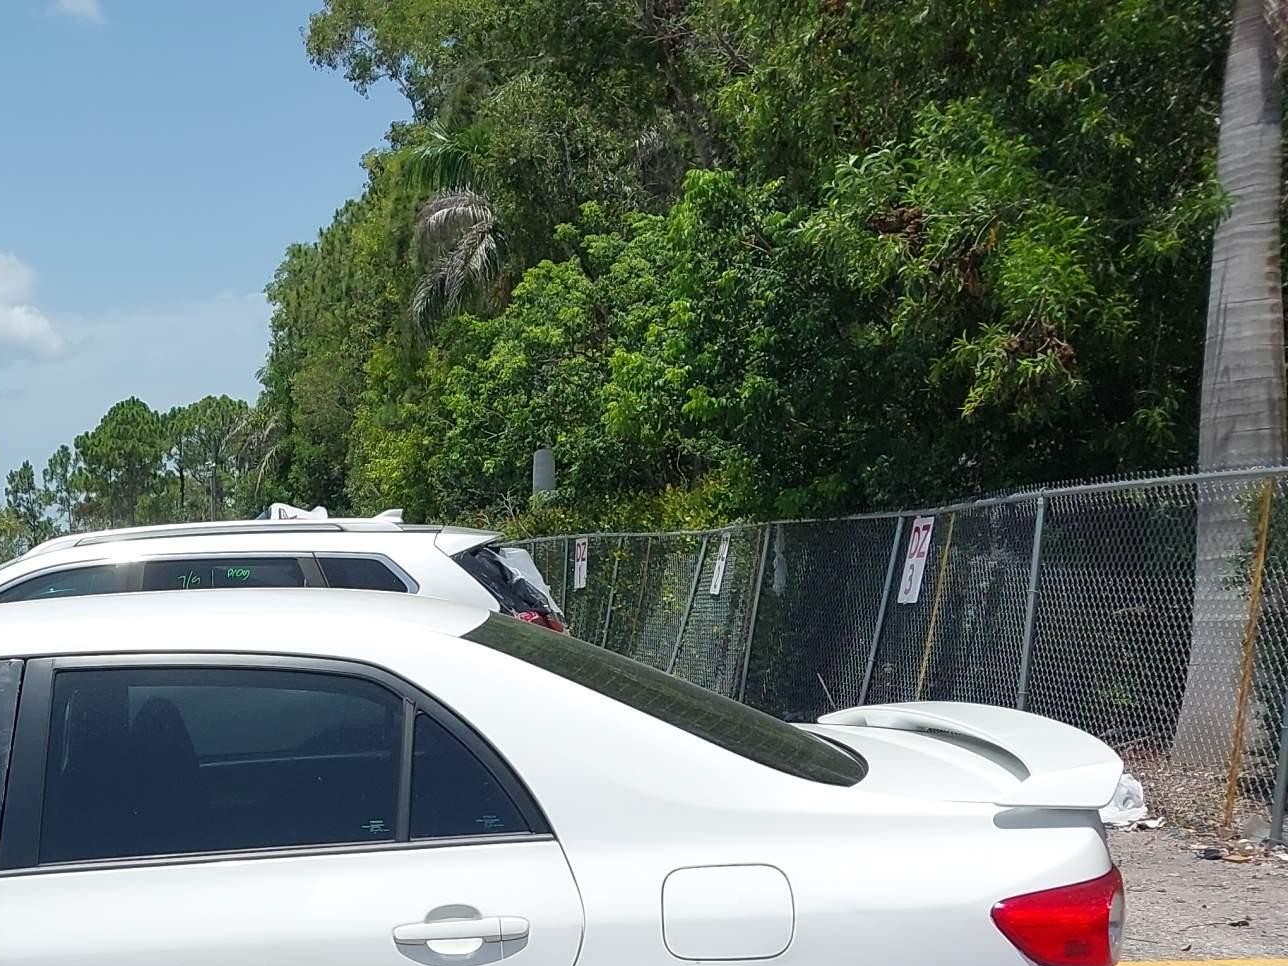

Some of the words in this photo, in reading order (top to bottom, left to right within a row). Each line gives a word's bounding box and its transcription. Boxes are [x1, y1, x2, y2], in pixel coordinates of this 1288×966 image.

[576, 541, 587, 563] DZ
[908, 523, 932, 559] DZ
[903, 563, 915, 596] 3
